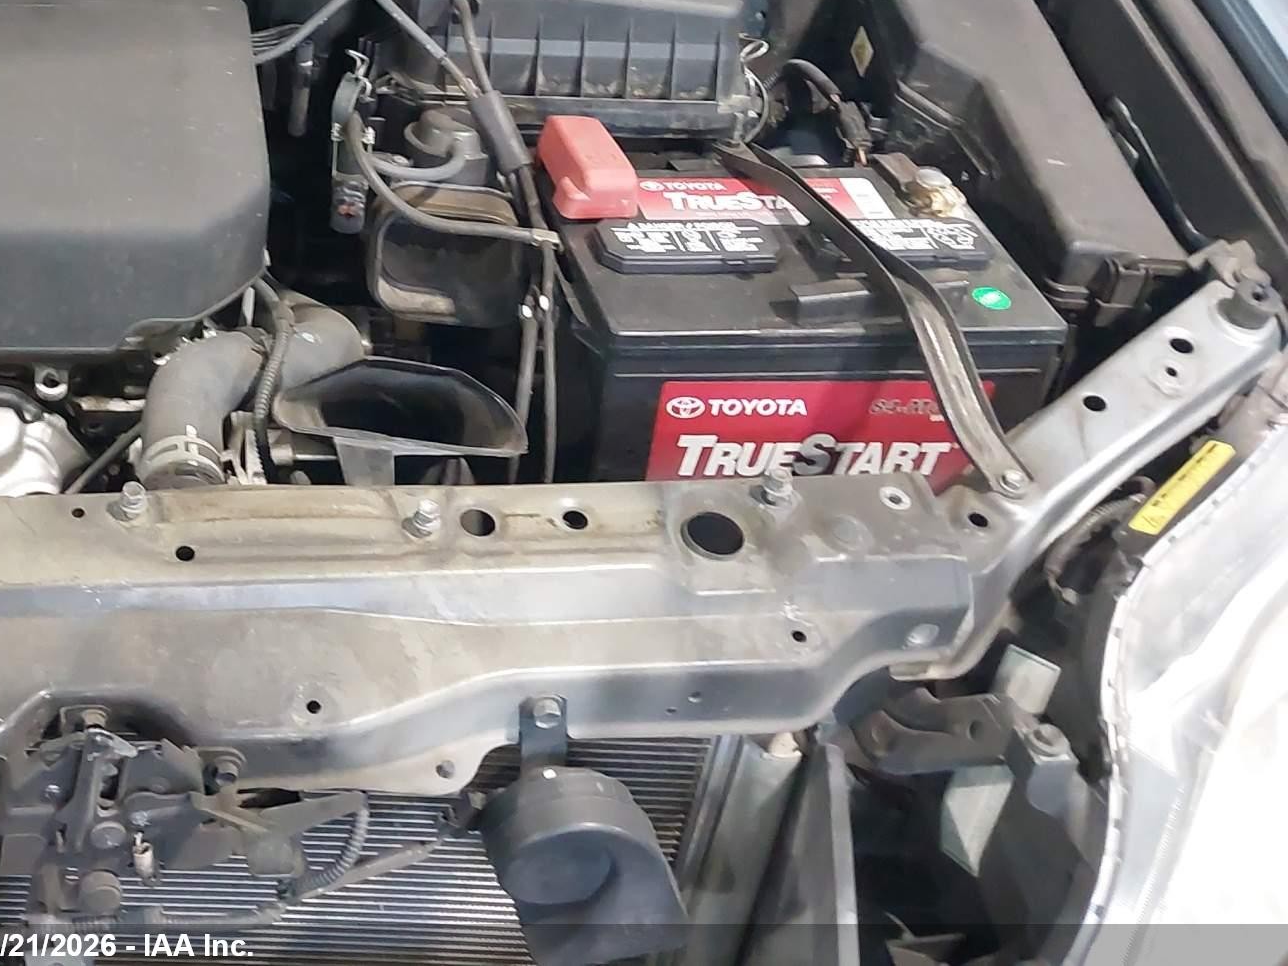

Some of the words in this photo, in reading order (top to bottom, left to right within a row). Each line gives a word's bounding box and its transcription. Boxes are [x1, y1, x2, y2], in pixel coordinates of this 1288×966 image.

[663, 181, 727, 191] TOYOTA
[662, 191, 789, 211] TRUESTA
[708, 398, 807, 416] TOYOTA
